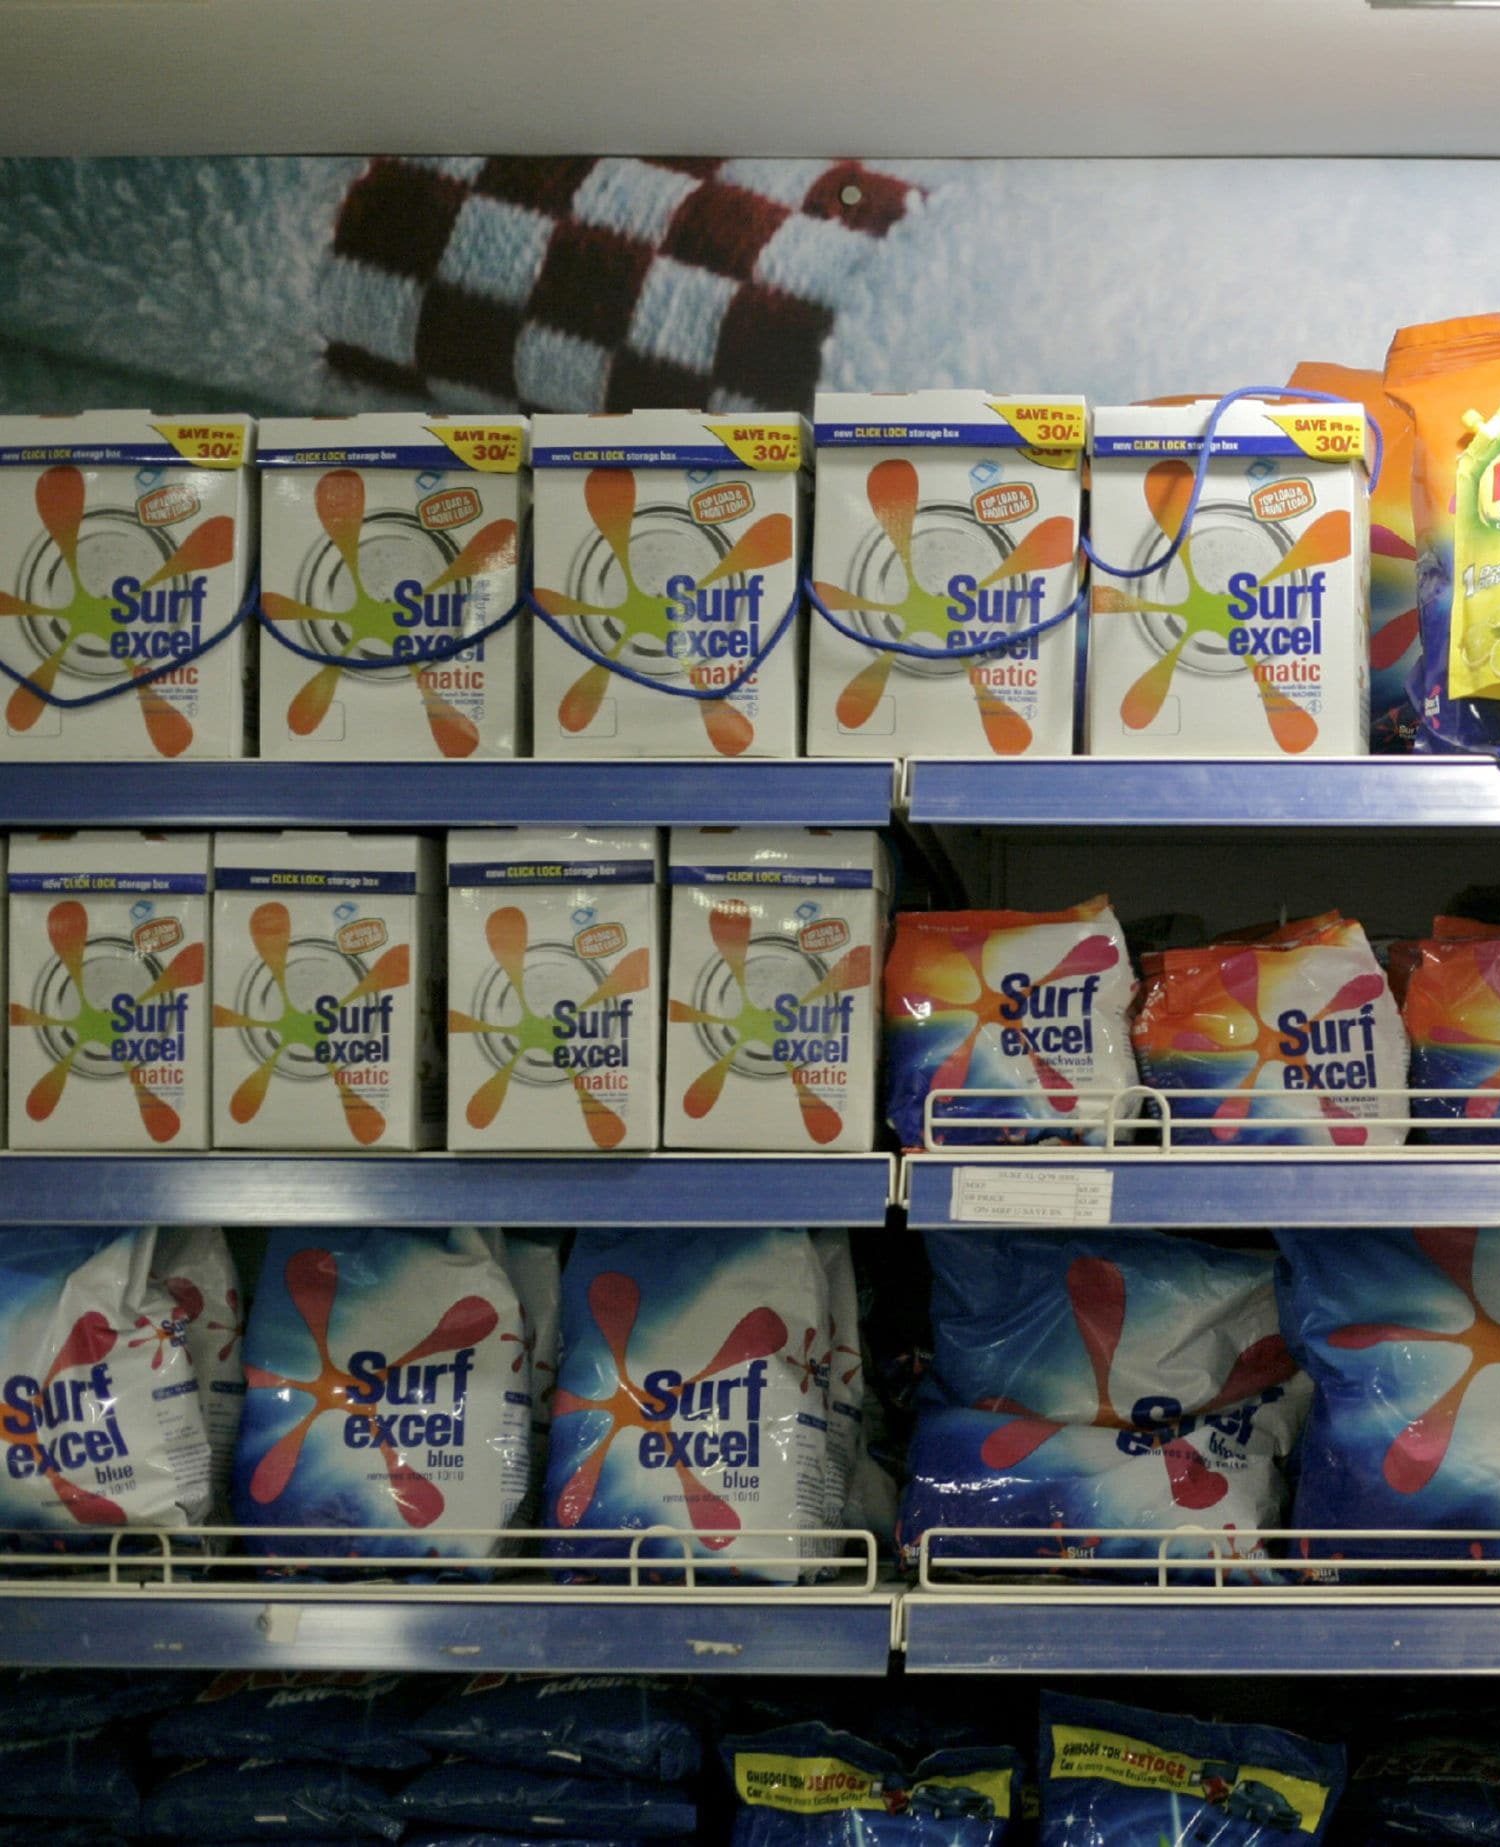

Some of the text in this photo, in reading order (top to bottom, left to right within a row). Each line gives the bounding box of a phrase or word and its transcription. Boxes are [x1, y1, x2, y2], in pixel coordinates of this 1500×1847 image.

[1016, 409, 1048, 420] SAVE
[1295, 420, 1326, 431] SAVE
[734, 430, 764, 440] SAVE
[855, 428, 881, 438] CLICK
[883, 428, 907, 437] LOCK
[909, 429, 942, 438] storage
[1037, 424, 1080, 440] 30/-
[1316, 435, 1359, 452] 30/-
[572, 451, 599, 461] CLICK
[601, 451, 624, 460] LOCK
[754, 444, 797, 461] 30/-
[1464, 564, 1475, 598] 1
[110, 576, 207, 623] Surf
[665, 575, 764, 622] Surf
[947, 574, 1045, 623] Surf
[1228, 572, 1325, 620] Surf
[110, 625, 200, 659] excel
[666, 623, 759, 658] excel
[1228, 620, 1321, 655] excel
[416, 666, 484, 689] matic
[969, 663, 1037, 686] matic
[1254, 658, 1320, 682] matic
[272, 874, 298, 885] CLICK
[300, 875, 325, 885] LOCK
[507, 866, 535, 878] CLICK
[537, 866, 562, 877] LOCK
[1000, 973, 1100, 1020] Surf
[111, 993, 188, 1033] Surf
[314, 995, 393, 1034] Surf
[552, 999, 633, 1039] Surf
[774, 993, 854, 1033] Surf
[1001, 1018, 1093, 1056] excel
[1278, 1003, 1375, 1056] Surf
[111, 1034, 185, 1062] excel
[315, 1034, 389, 1064] excel
[553, 1040, 628, 1069] excel
[773, 1034, 848, 1063] excel
[129, 1063, 184, 1085] matic
[334, 1065, 388, 1085] matic
[573, 1069, 628, 1090] matic
[792, 1065, 847, 1085] matic
[1283, 1053, 1376, 1090] excel
[346, 1348, 475, 1404] Surf
[641, 1360, 767, 1421] Surf
[3, 1363, 112, 1435] Surf
[344, 1404, 464, 1449] excel
[7, 1415, 128, 1479] excel
[427, 1450, 464, 1467] blue
[639, 1422, 759, 1468] excel
[95, 1465, 134, 1484] blue
[723, 1472, 759, 1488] blue
